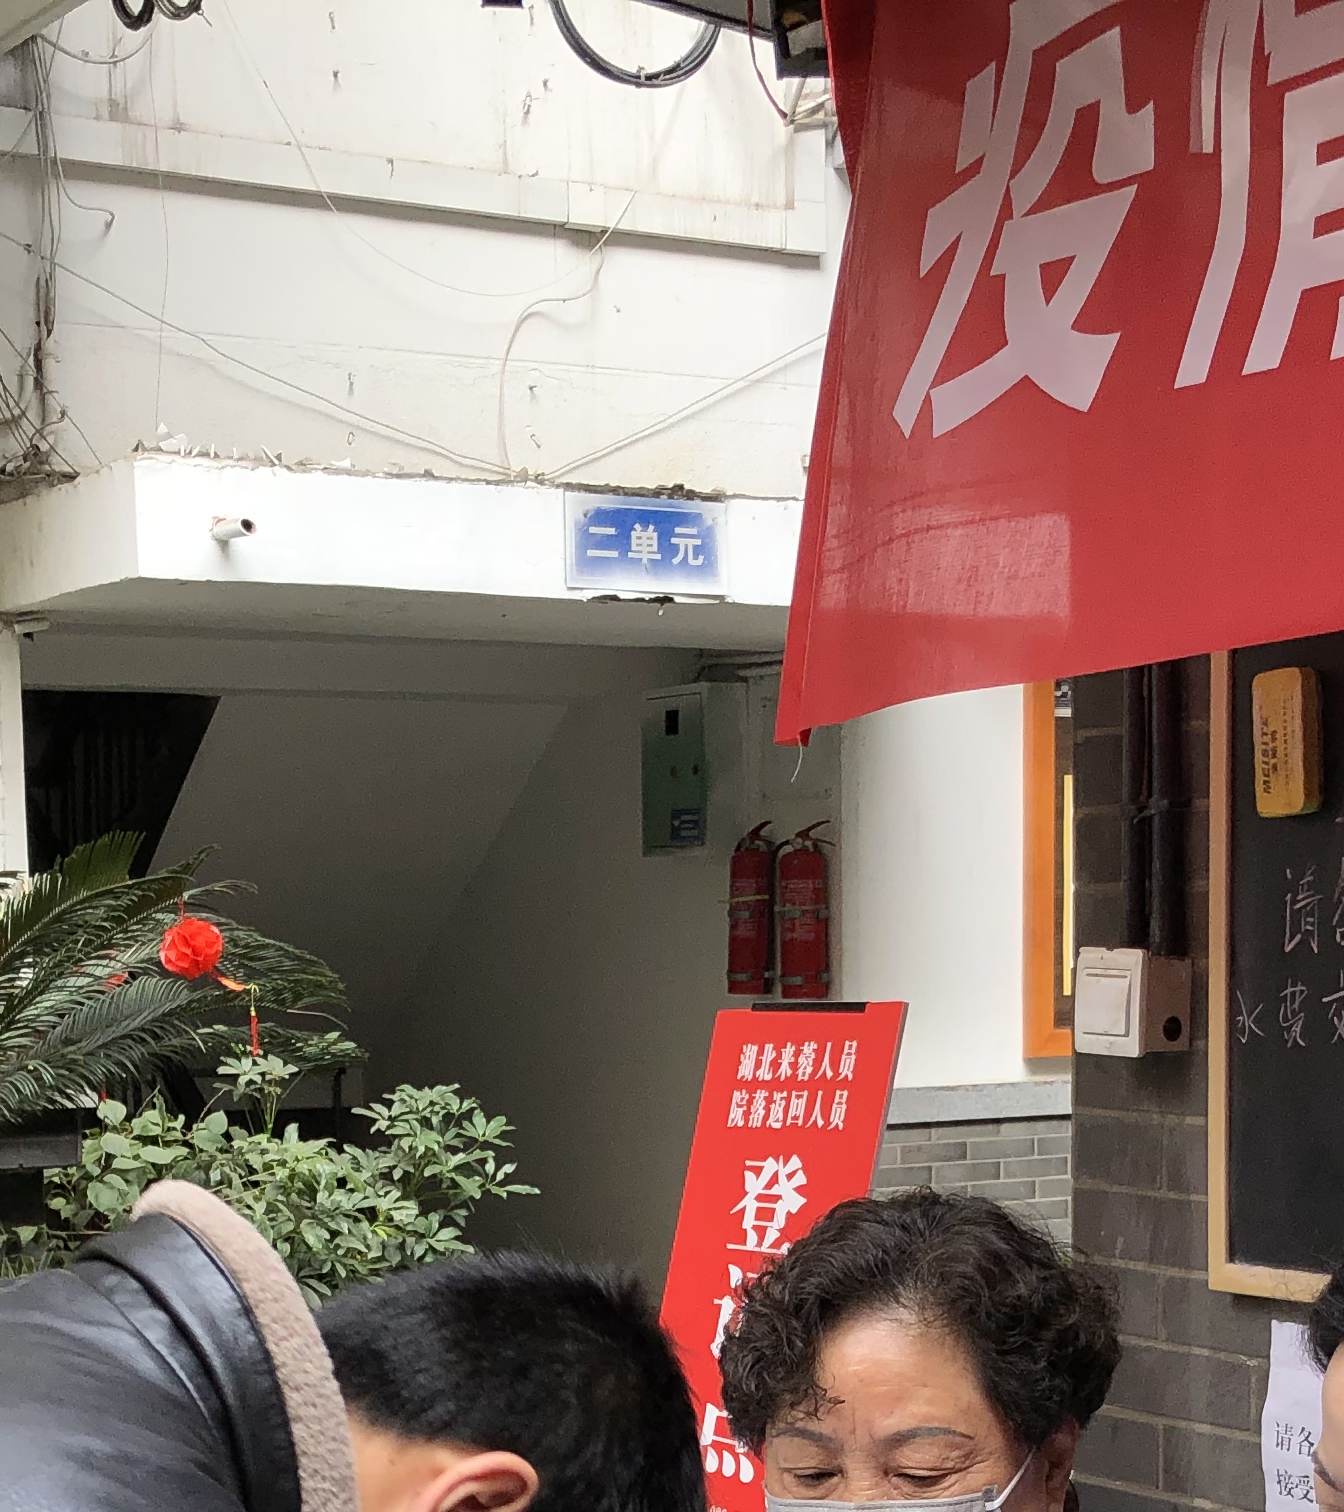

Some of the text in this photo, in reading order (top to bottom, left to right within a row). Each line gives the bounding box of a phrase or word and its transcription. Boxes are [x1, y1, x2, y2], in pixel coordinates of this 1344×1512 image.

[586, 523, 704, 566] 二单元
[736, 1040, 858, 1082] 湖北来蓉人员
[727, 1088, 849, 1131] 院落返回人员
[1274, 1421, 1315, 1458] 请各
[1276, 1468, 1315, 1505] 接受
